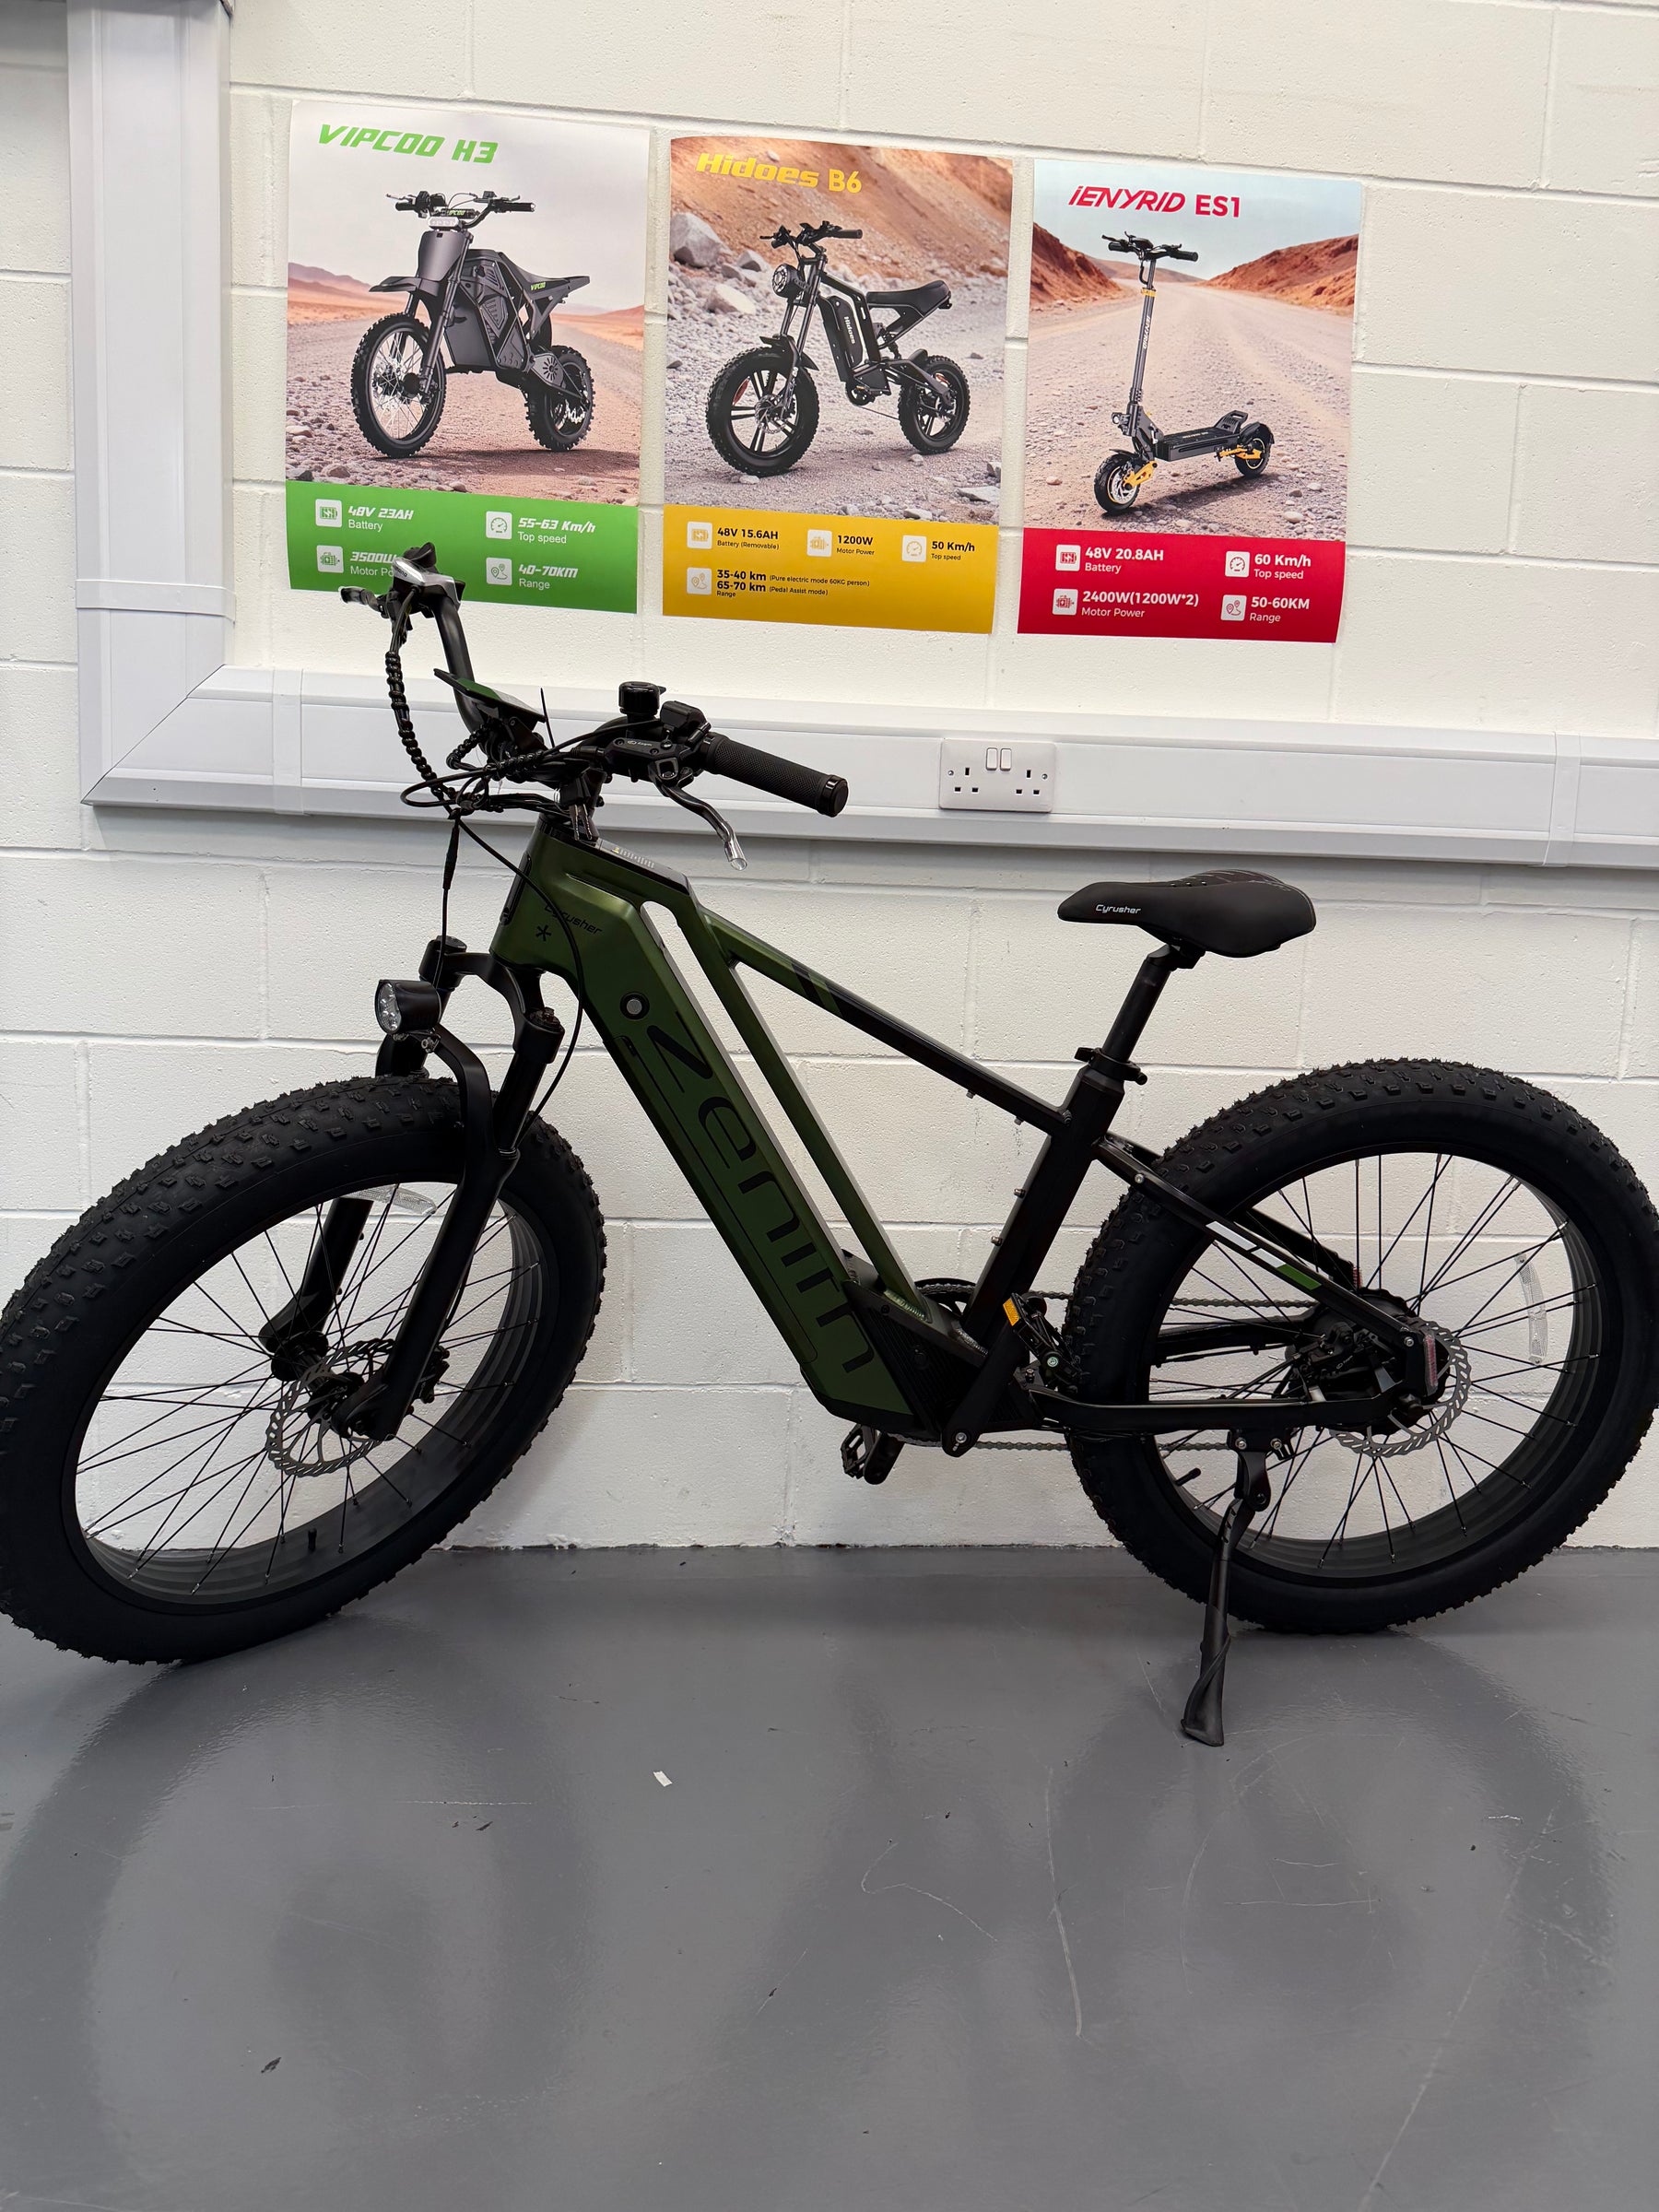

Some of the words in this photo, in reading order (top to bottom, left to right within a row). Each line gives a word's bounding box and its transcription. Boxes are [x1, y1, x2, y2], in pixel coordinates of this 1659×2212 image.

[319, 124, 445, 158] VIPCOO
[451, 139, 499, 164] H3
[696, 153, 820, 188] Hidoes
[829, 169, 862, 194] B6
[1195, 194, 1241, 218] ES1
[347, 506, 376, 517] 48V
[378, 508, 414, 520] 23AH
[348, 519, 383, 533] Battery
[518, 517, 559, 530] 55-63
[561, 521, 596, 534] Km/h
[517, 531, 535, 543] Top
[537, 535, 567, 545] speed
[717, 527, 738, 537] 48V
[741, 529, 779, 539] 15.6AH
[717, 540, 740, 548] Battery
[741, 542, 780, 550] (Removable)
[837, 535, 874, 546] 1200W
[932, 541, 945, 550] 50
[947, 542, 975, 552] Km/h
[1085, 547, 1112, 559] 48V
[1115, 548, 1164, 561] 20.8AH
[1254, 553, 1271, 565] 60
[1275, 554, 1312, 569] Km/h
[350, 565, 379, 576] Motor
[518, 564, 579, 579] 40-70KM
[1085, 562, 1122, 574] Battery
[717, 569, 747, 580] 35-40
[749, 571, 767, 582] km
[1253, 569, 1272, 580] Top
[1274, 571, 1304, 581] speed
[519, 578, 550, 591] Range
[717, 581, 747, 591] 65-70
[749, 582, 766, 592] km
[716, 590, 736, 598] Range
[1251, 596, 1311, 610] 50-60KM
[1081, 607, 1112, 618] Motor
[1113, 608, 1146, 618] Power
[1250, 612, 1281, 624] Range
[1095, 904, 1142, 914] Cyrusher
